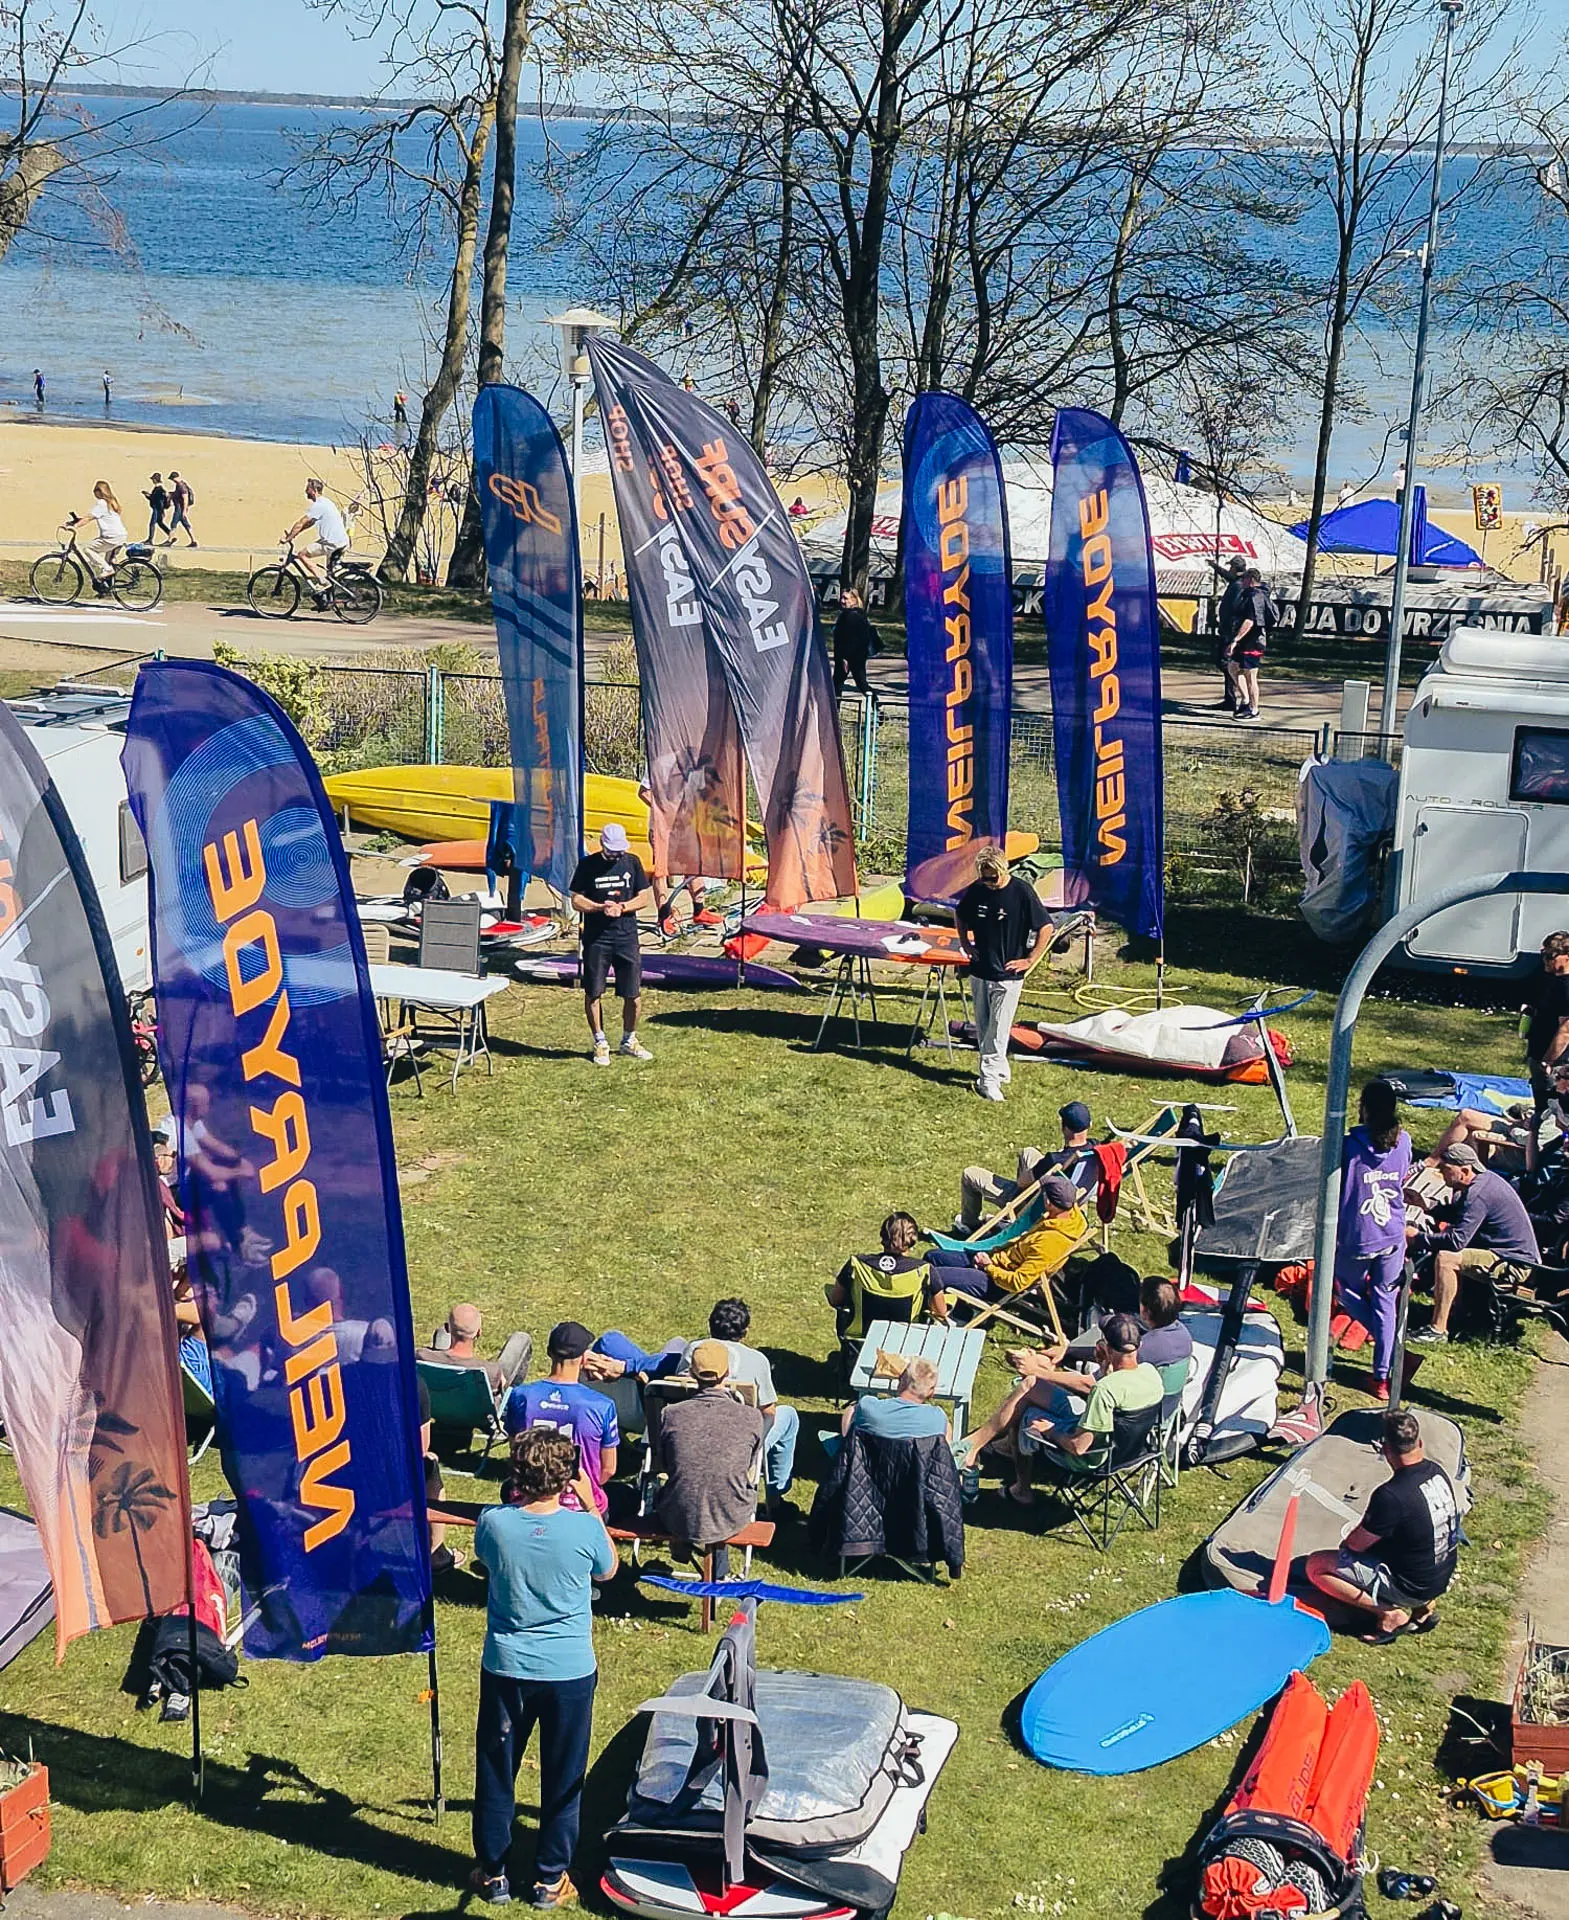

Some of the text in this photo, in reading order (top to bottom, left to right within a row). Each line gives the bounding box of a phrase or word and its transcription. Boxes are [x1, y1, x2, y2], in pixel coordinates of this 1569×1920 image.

[1344, 607, 1382, 634] DO
[1405, 793, 1452, 805] AUTO
[1470, 797, 1545, 811] ROLLER
